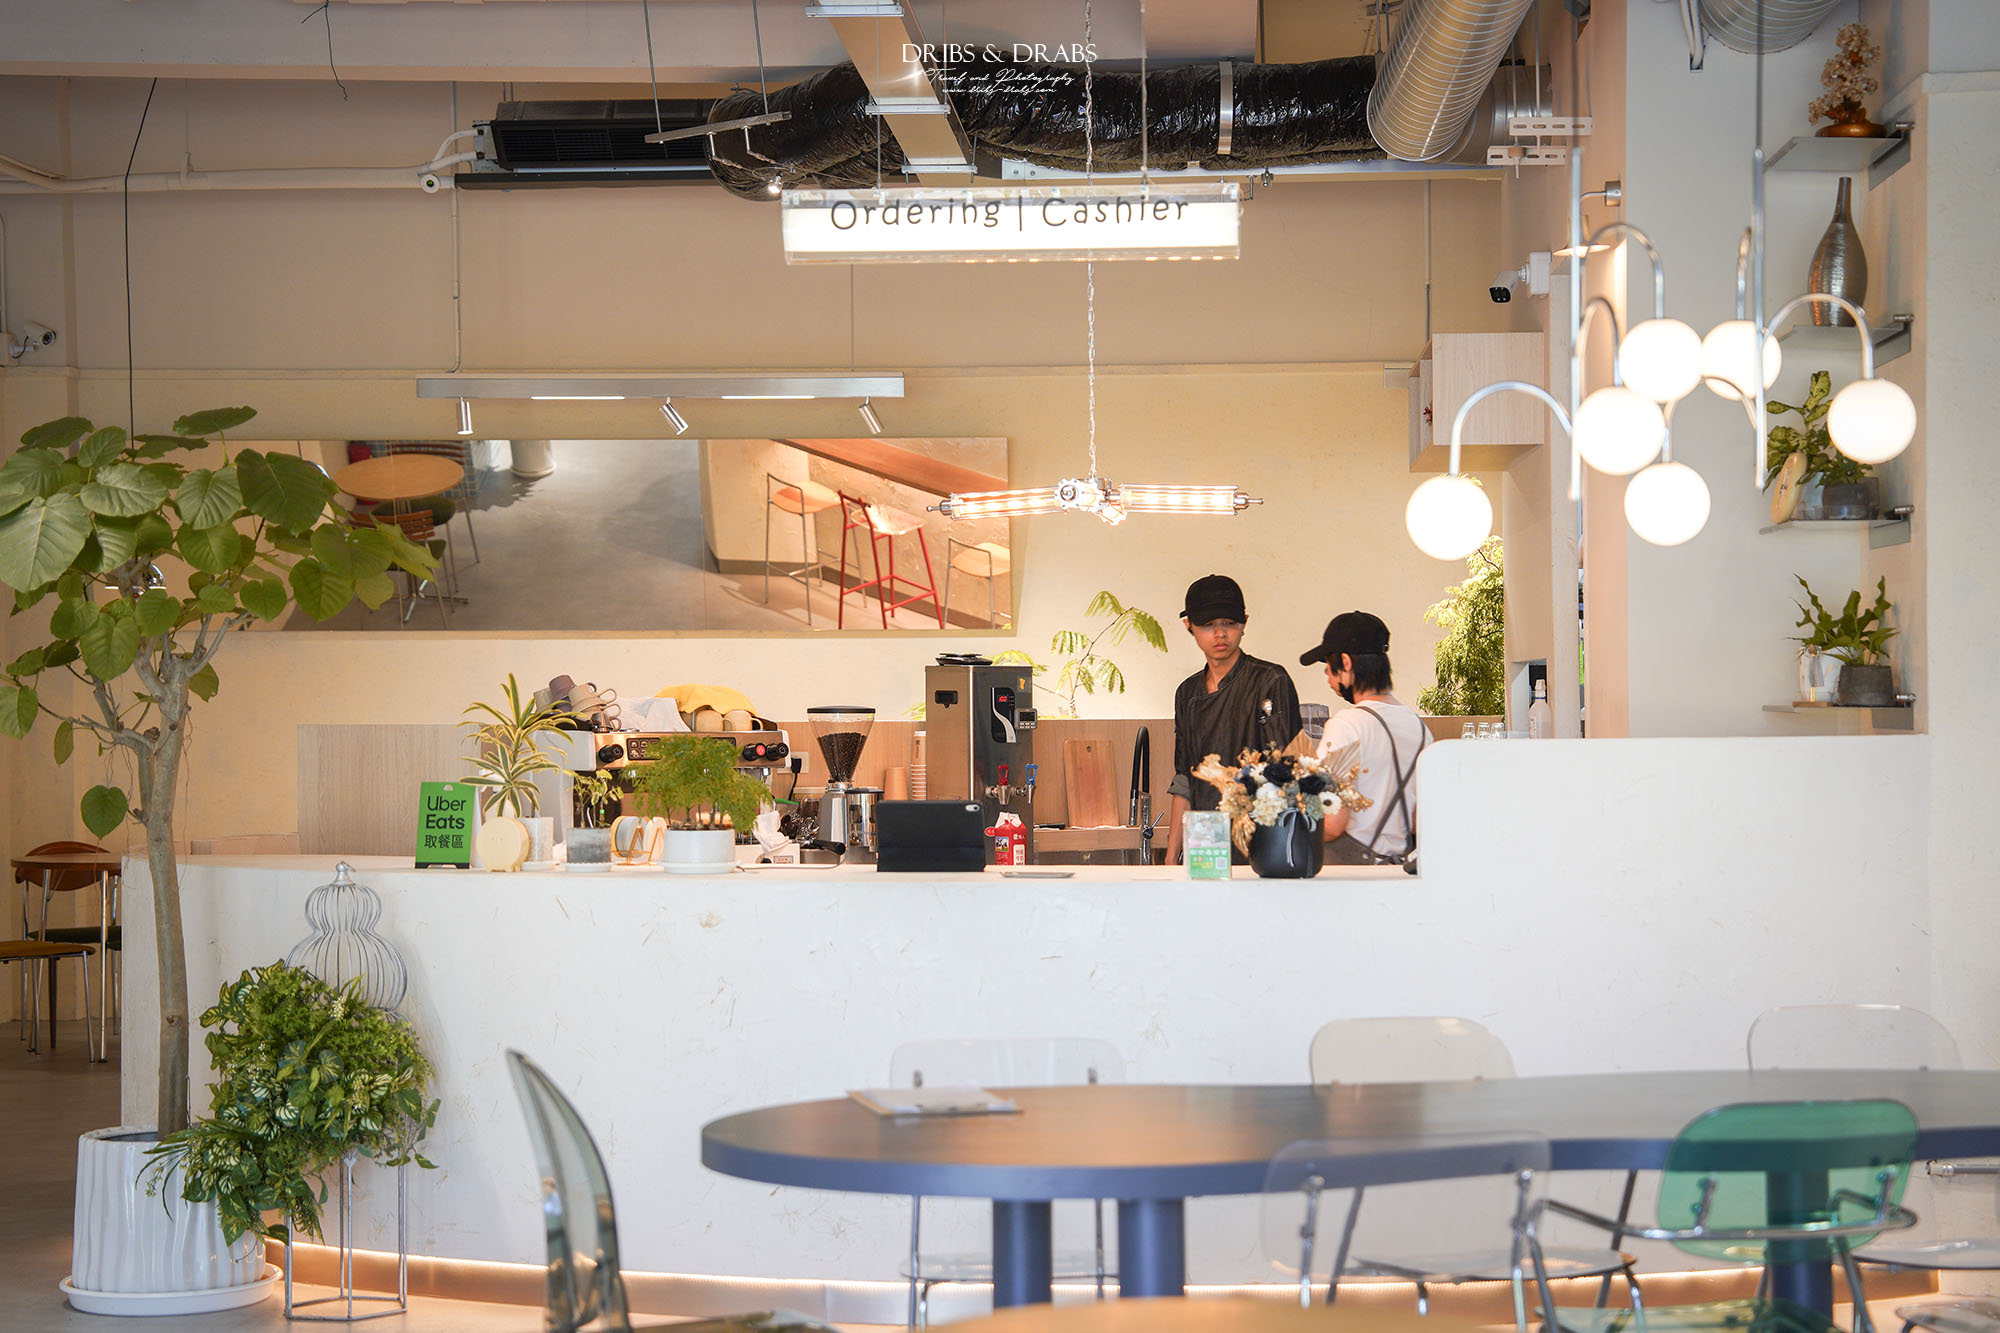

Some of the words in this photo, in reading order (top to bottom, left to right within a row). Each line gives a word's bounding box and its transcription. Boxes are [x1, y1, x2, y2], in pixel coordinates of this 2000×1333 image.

[831, 198, 1001, 230] Ordering
[1042, 196, 1189, 227] Cashier
[427, 795, 467, 811] Uber
[426, 814, 465, 829] Eats
[424, 834, 464, 848] 取餐區
